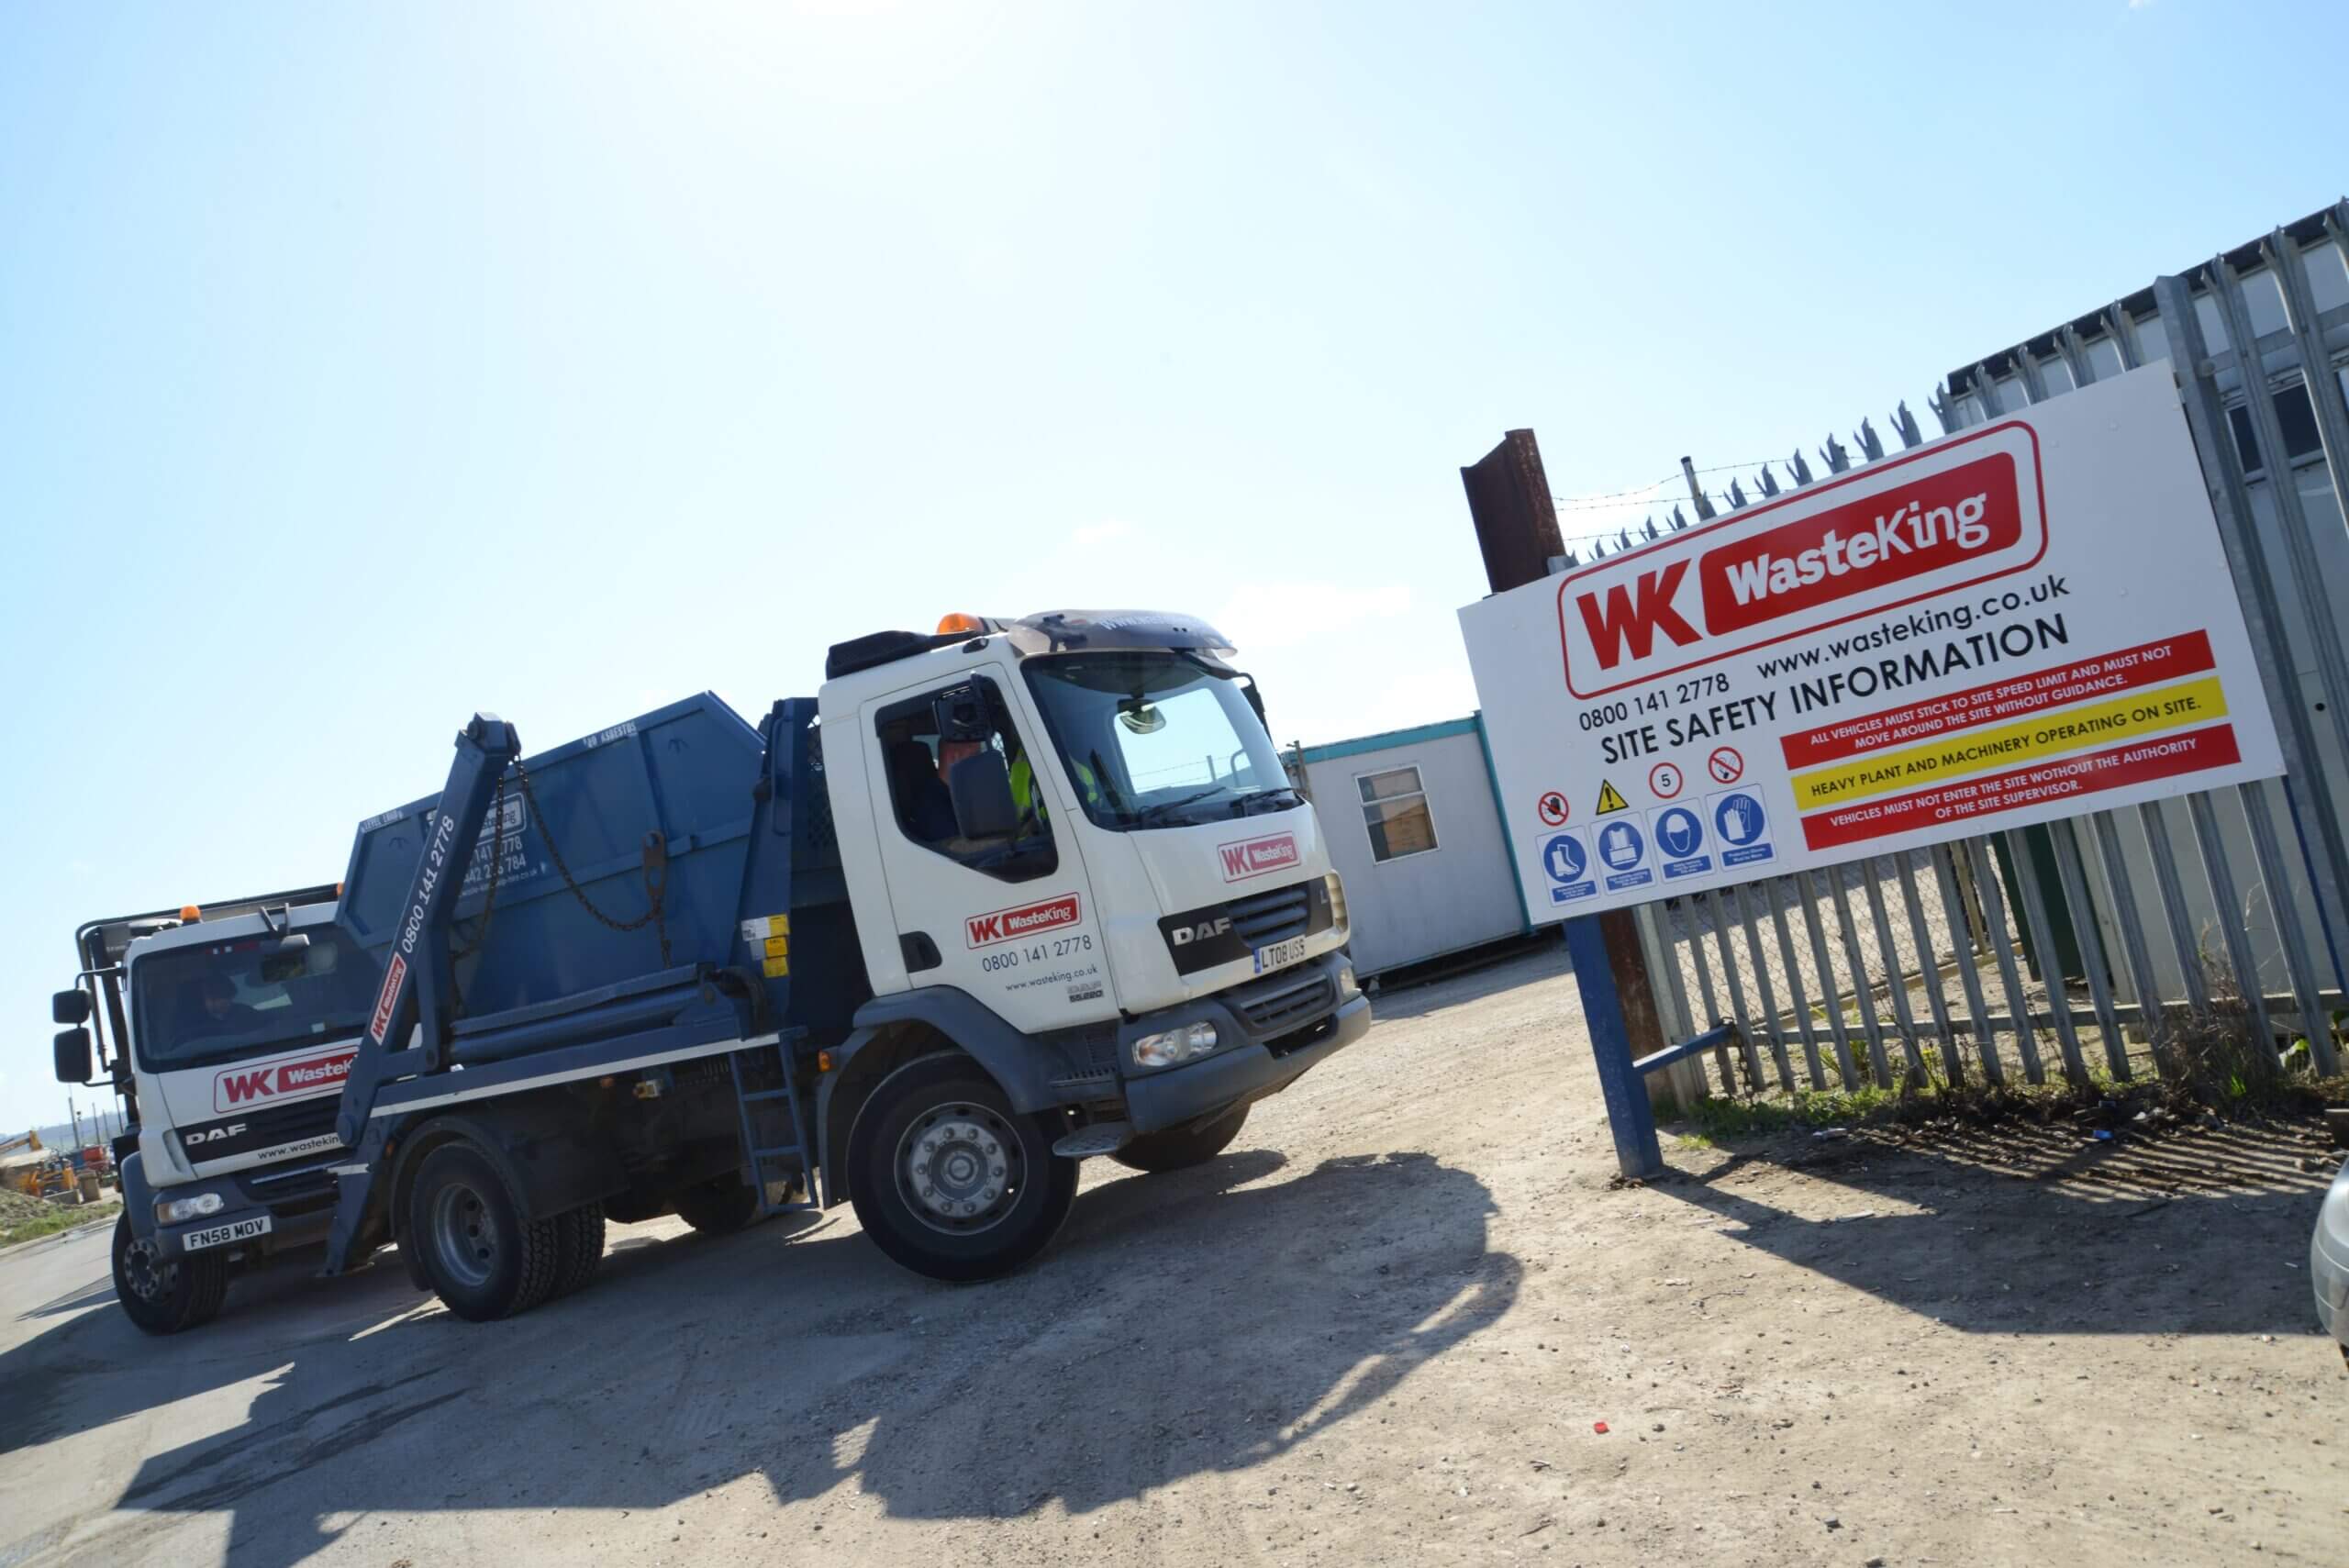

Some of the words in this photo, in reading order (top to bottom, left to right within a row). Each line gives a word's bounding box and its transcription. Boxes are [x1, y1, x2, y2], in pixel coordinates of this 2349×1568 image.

[1576, 558, 1704, 671] WK
[1725, 492, 1989, 606] WasteKing
[1579, 702, 1628, 731] 0800
[1634, 690, 1669, 715] 141
[1676, 673, 1730, 705] 2778
[1757, 574, 2070, 679] www.wasteking.co.uk
[1601, 725, 1659, 764] SITE
[1666, 691, 1776, 747] SAFETY
[1789, 613, 2070, 715] INFORMATION
[1810, 731, 1831, 746] ALL
[1830, 718, 1883, 740] VEHICLES
[1884, 710, 1915, 727] MUST
[1918, 702, 1951, 719] STICK
[1951, 696, 1968, 709] TO
[1972, 690, 1994, 705] SITE
[1997, 682, 2033, 699] SPEED
[2035, 672, 2067, 689] LIMIT
[2070, 663, 2100, 681] AND
[2103, 654, 2139, 673] MUST
[2142, 645, 2172, 662] NOT
[1854, 732, 1890, 750] MOVE
[1893, 719, 1943, 740] AROUND
[1945, 712, 1967, 726] THE
[1969, 706, 1992, 720] SITE
[1994, 689, 2049, 716] WITHOUT
[2051, 673, 2128, 701] GUIDANCE.
[1811, 776, 1856, 796] HEAVY
[1860, 765, 1901, 785] PLANT
[1906, 757, 1938, 775] AND
[1941, 734, 2031, 767] MACHINERY
[2035, 713, 2127, 746] OPERATING
[2132, 706, 2160, 724] ON
[2165, 696, 2202, 716] SITE.
[1661, 773, 1671, 787] 5
[1830, 805, 1882, 827] VEHICLES
[1884, 799, 1914, 816] MUST
[1916, 795, 1941, 808] NOT
[1943, 786, 1979, 802] ENTER
[1980, 780, 2002, 795] THE
[2004, 774, 2027, 790] SITE
[2029, 760, 2094, 784] WOTHOUT
[2096, 754, 2121, 769] THE
[2122, 738, 2197, 764] AUTHORITY
[1935, 806, 1953, 819] OF
[1954, 801, 1976, 815] THE
[1977, 795, 1999, 810] SITE
[2002, 780, 2084, 806] SUPERVISOR.
[506, 853, 527, 873] 784
[1221, 845, 1252, 876] WK
[402, 905, 424, 954] 0800
[418, 867, 438, 906] 141
[430, 815, 454, 867] 2778
[969, 916, 1002, 943] WK
[1008, 906, 1073, 929] WasteKing
[1172, 917, 1231, 946] DAF
[982, 951, 1019, 973] 0800
[1024, 945, 1048, 963] 141
[1053, 935, 1092, 957] 2778
[1261, 946, 1288, 969] LT08
[1006, 963, 1098, 991] www.wasteking.co.uk
[223, 1069, 275, 1104] WK
[287, 1053, 359, 1085] WasteK
[185, 1123, 248, 1145] DAF
[258, 1135, 342, 1161] www.wastekin
[190, 1228, 230, 1249] FN58
[235, 1218, 264, 1239] MOV
